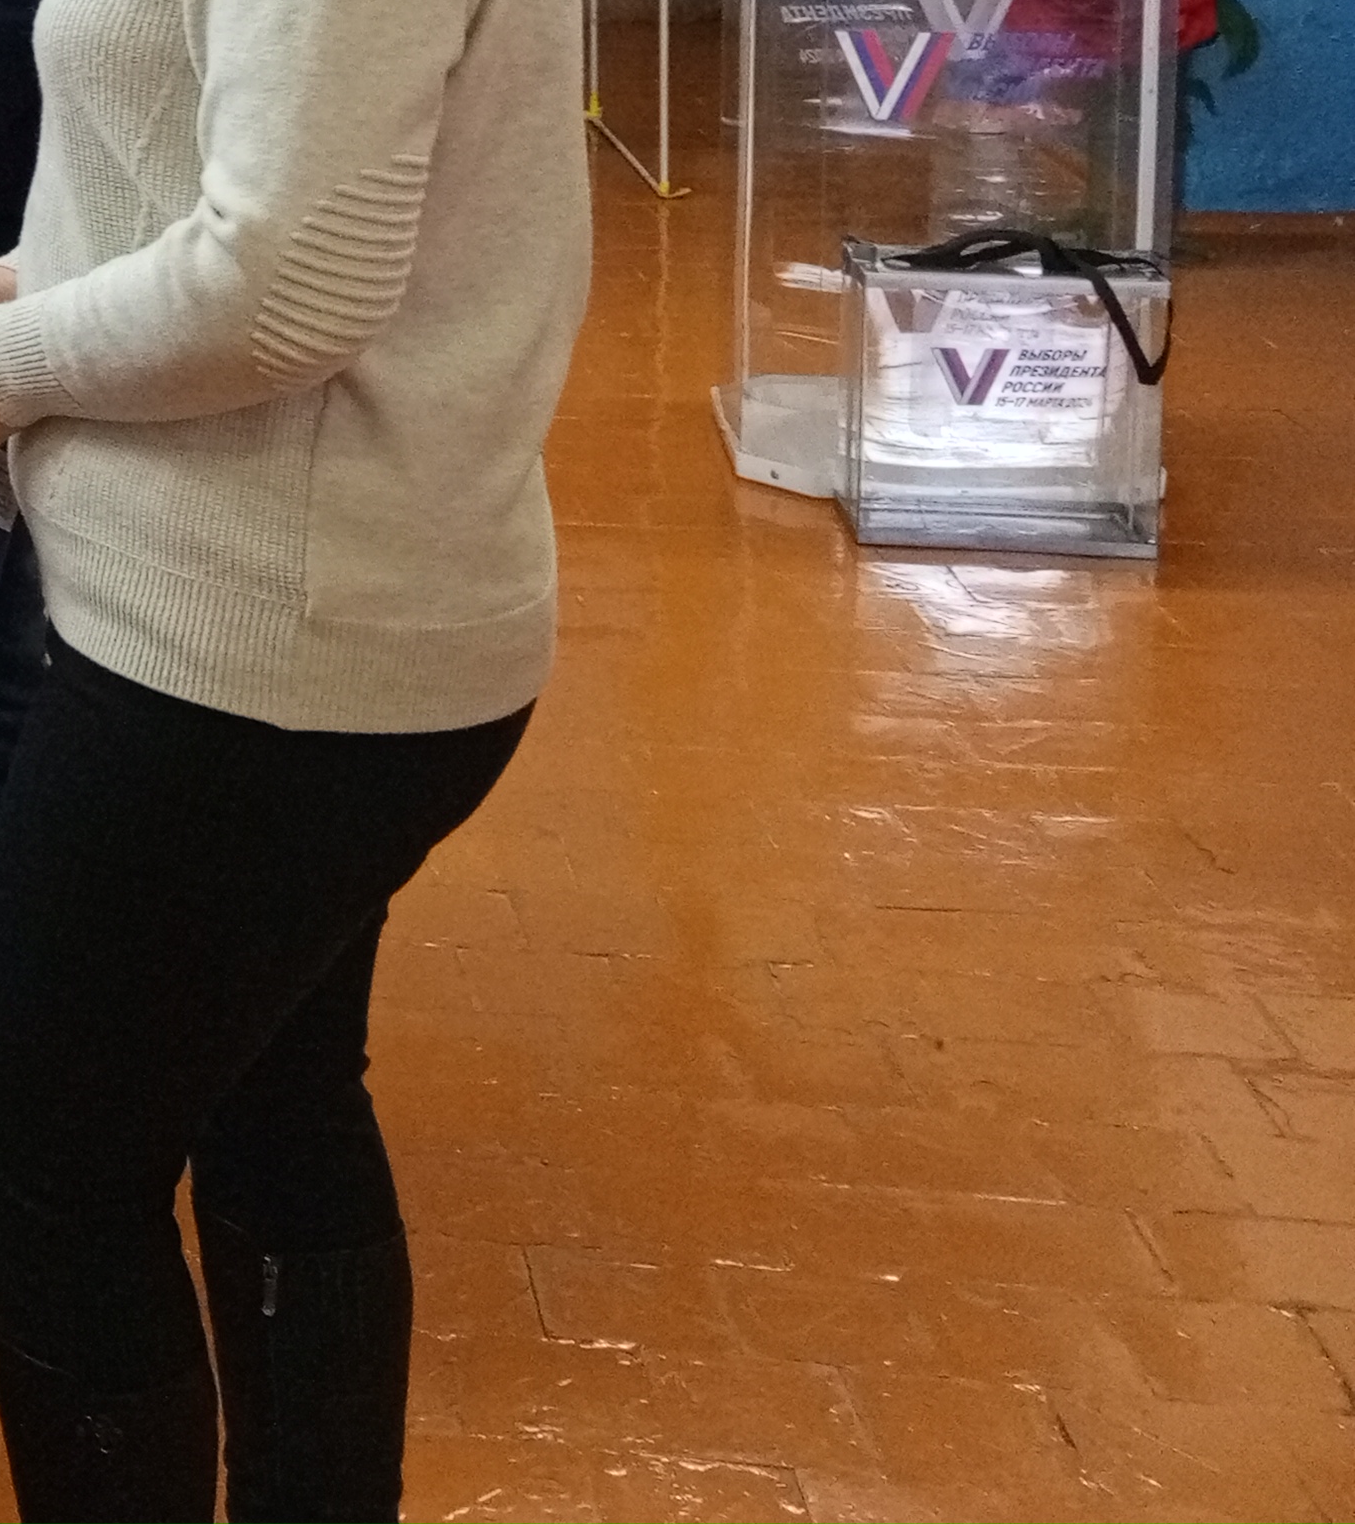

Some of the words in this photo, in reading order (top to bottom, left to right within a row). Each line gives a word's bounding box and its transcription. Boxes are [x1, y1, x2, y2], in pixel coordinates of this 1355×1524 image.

[1018, 349, 1088, 362] ВЫБОРЫ
[1009, 365, 1107, 379] ПРЕЗИДЕНТА
[1001, 381, 1066, 394] РОССИИ
